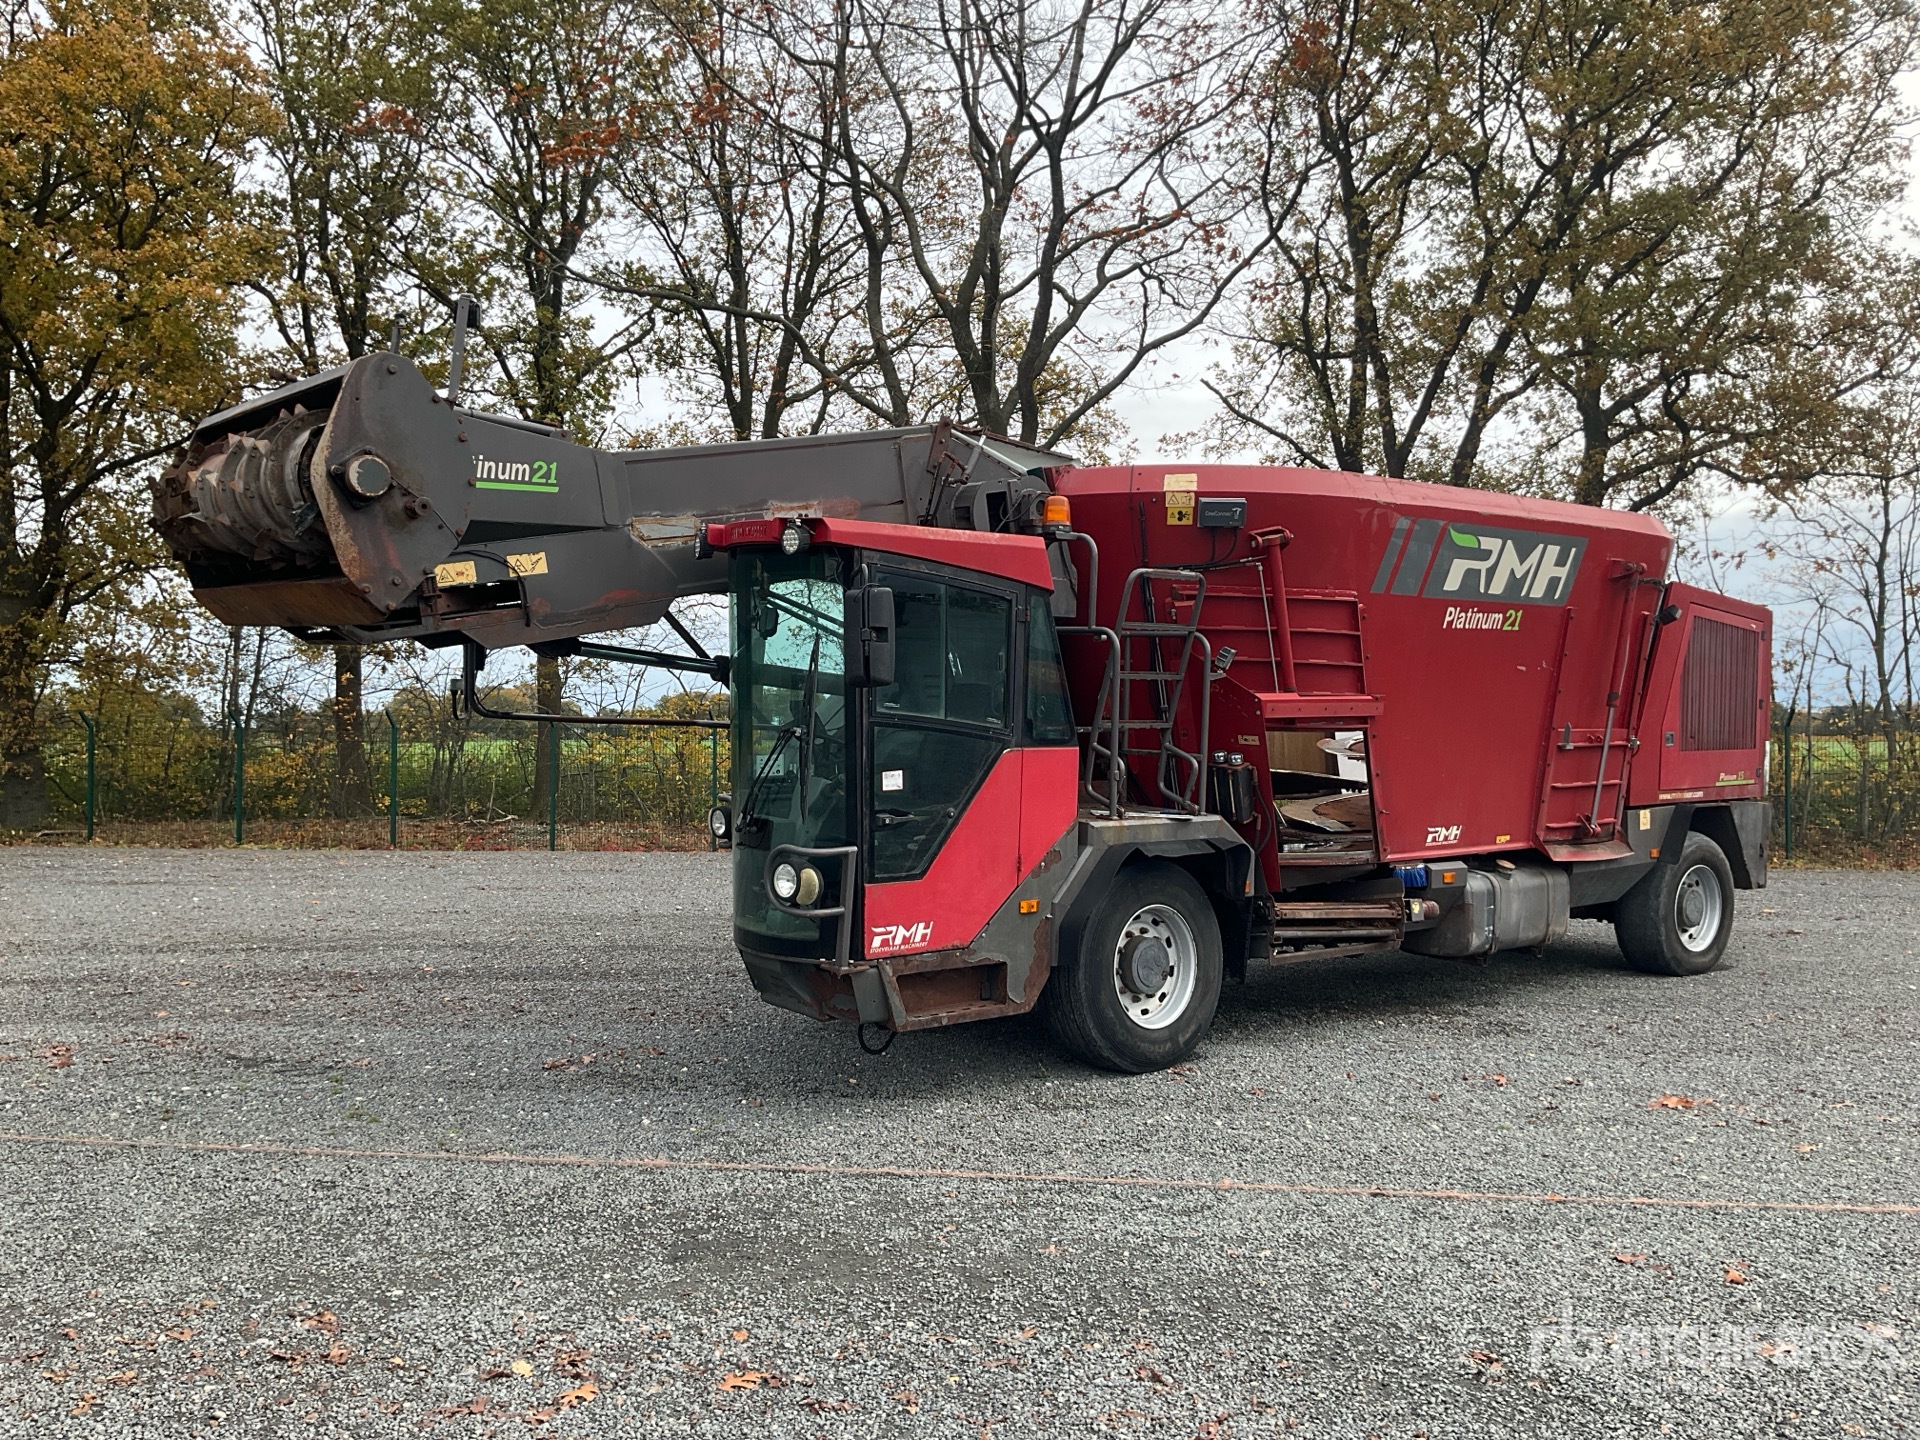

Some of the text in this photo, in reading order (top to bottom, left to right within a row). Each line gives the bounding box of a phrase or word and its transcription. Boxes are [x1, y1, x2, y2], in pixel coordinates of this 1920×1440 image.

[1443, 524, 1577, 600] RMH
[1426, 825, 1462, 842] RMH
[871, 921, 934, 948] RMH
